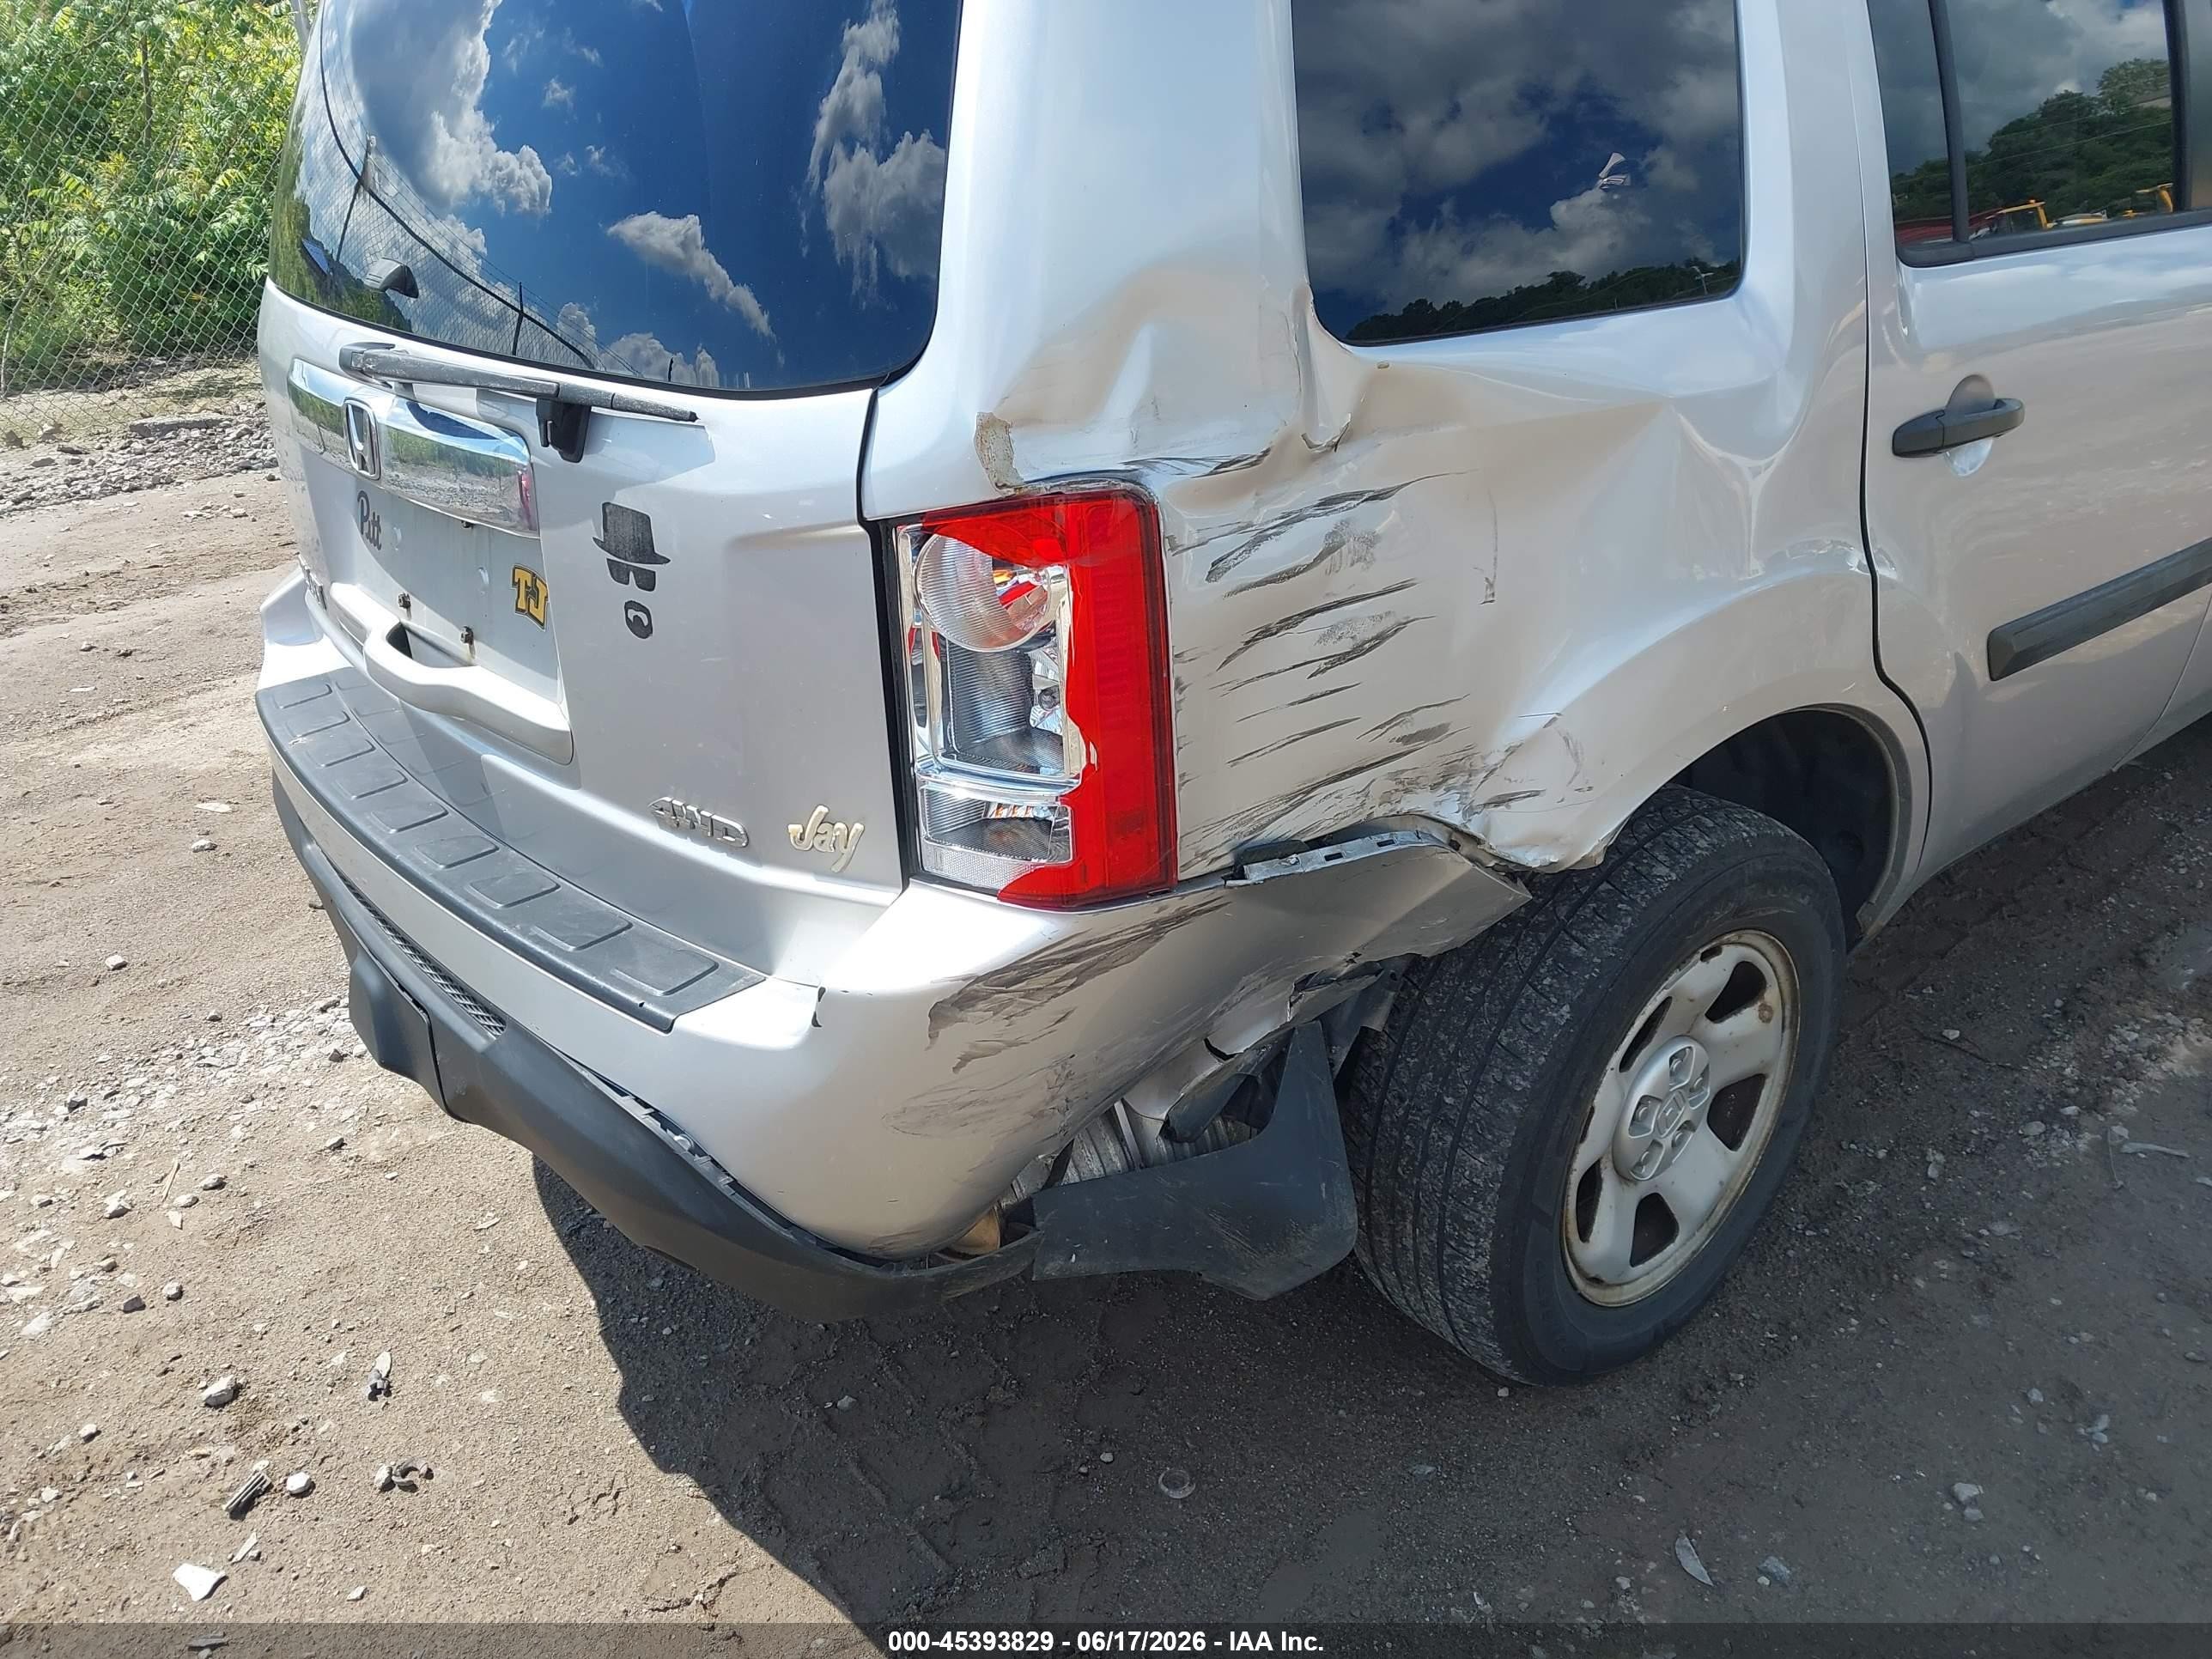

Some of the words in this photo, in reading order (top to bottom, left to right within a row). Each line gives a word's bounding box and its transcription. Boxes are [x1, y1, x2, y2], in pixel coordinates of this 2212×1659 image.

[356, 489, 382, 550] Pitt
[512, 565, 549, 629] TJ
[647, 796, 750, 848] 4WD
[787, 804, 865, 873] Jay
